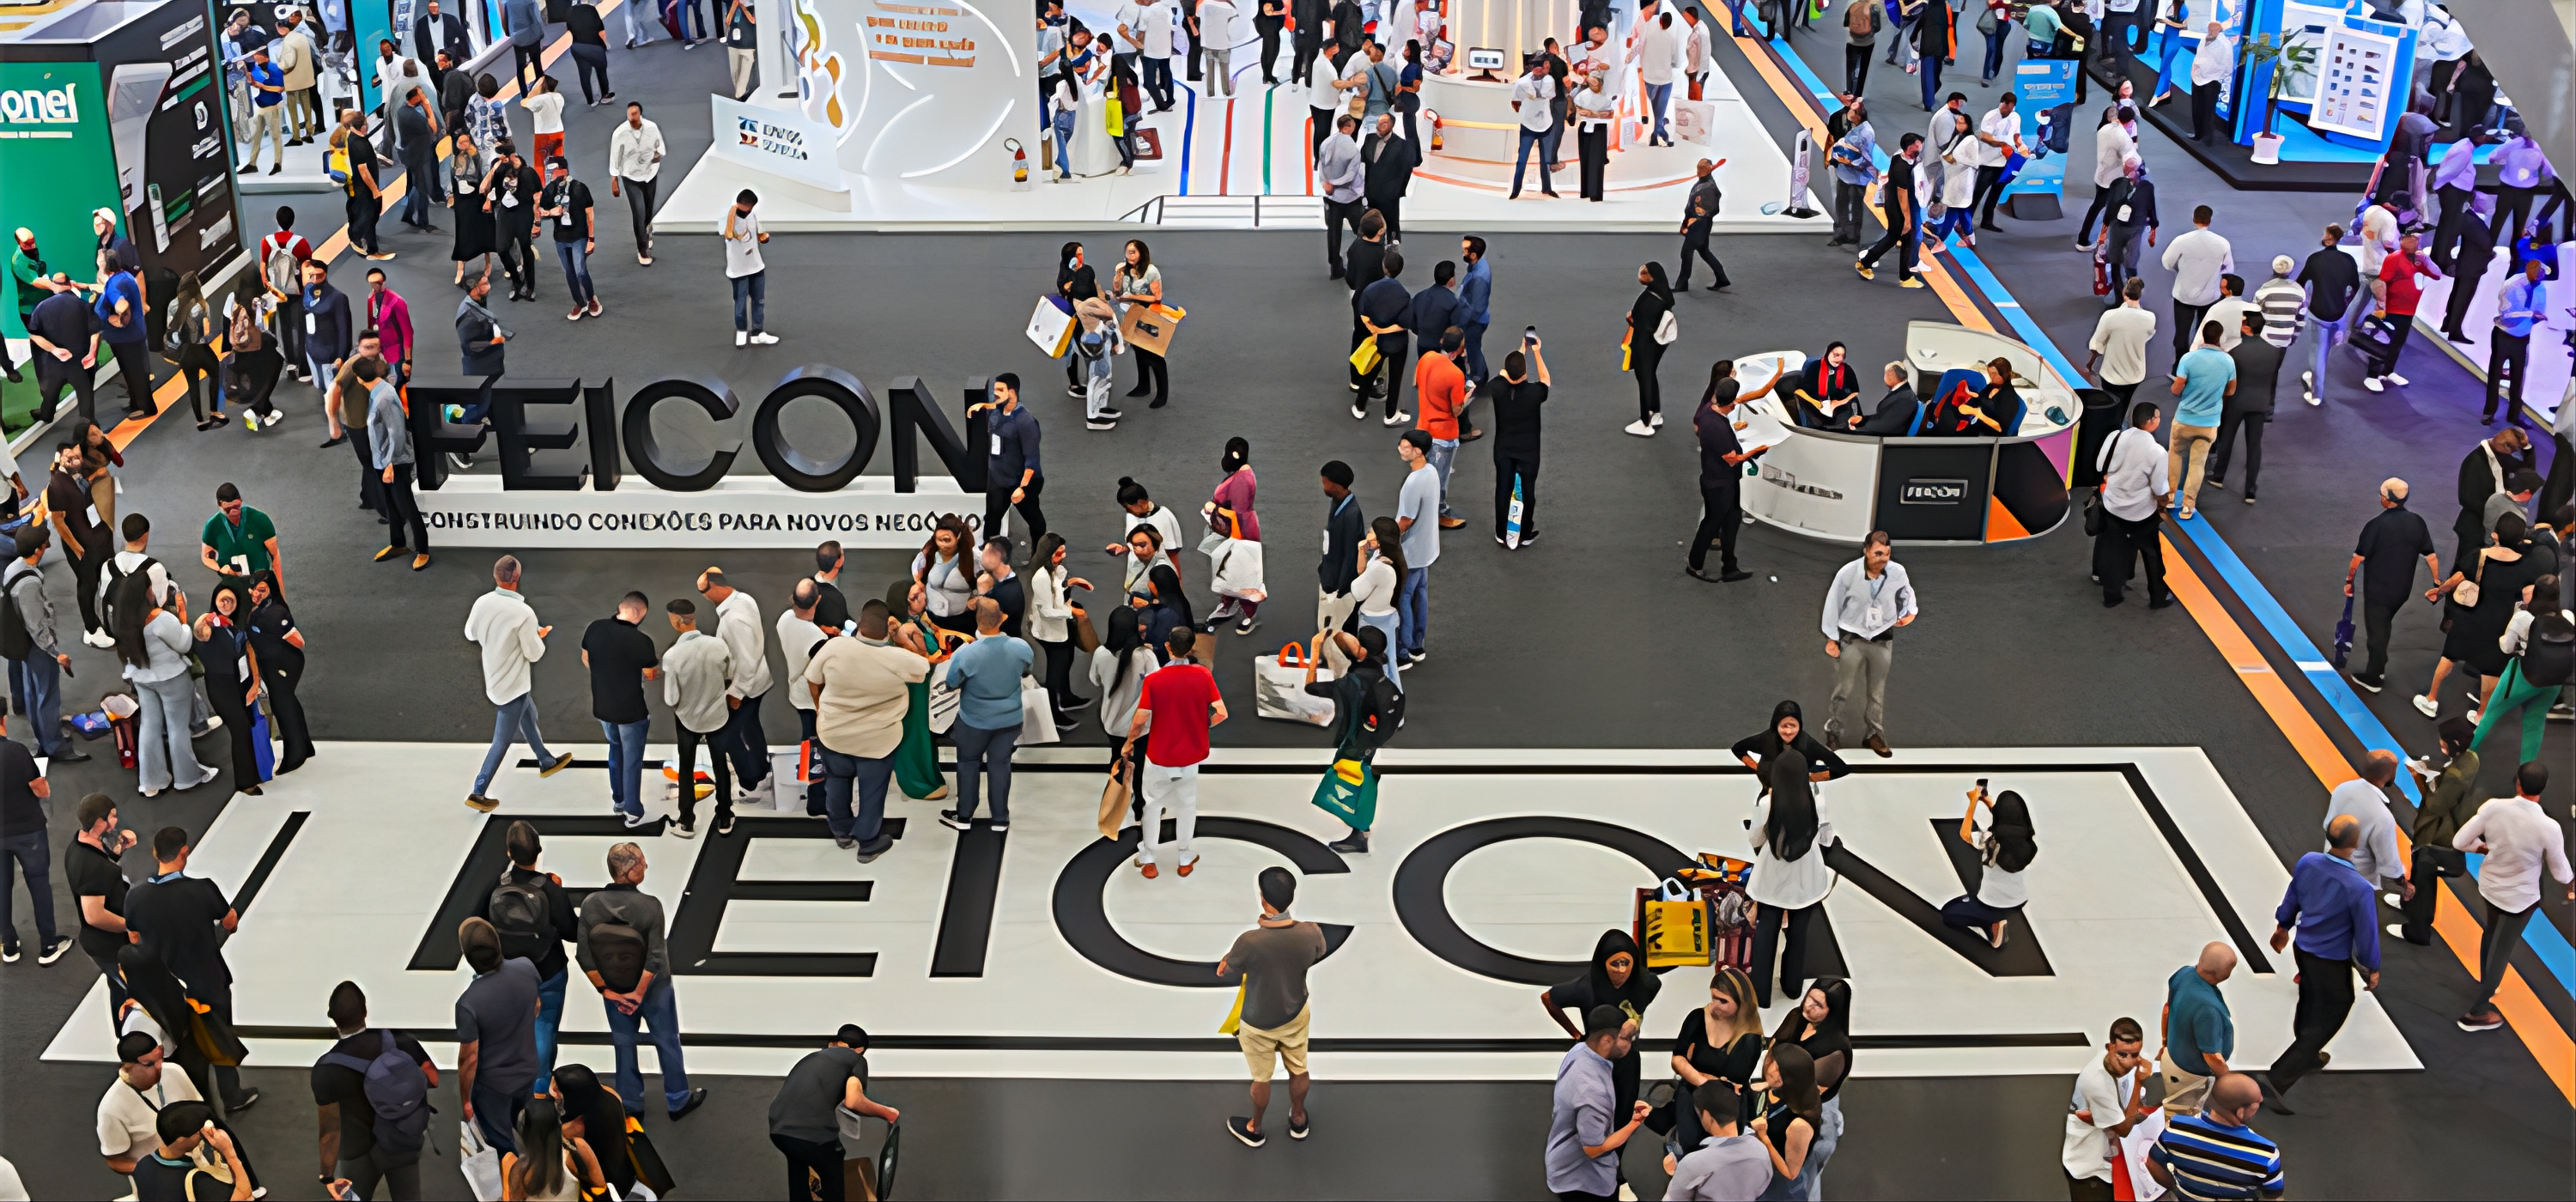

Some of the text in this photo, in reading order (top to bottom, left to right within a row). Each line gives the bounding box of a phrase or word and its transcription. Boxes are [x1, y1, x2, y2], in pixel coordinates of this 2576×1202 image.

[0, 83, 79, 123] onel
[407, 365, 988, 494] FEICON
[719, 513, 781, 531] PARA
[787, 513, 869, 531] NOVOS
[406, 814, 2056, 987] FEICON
